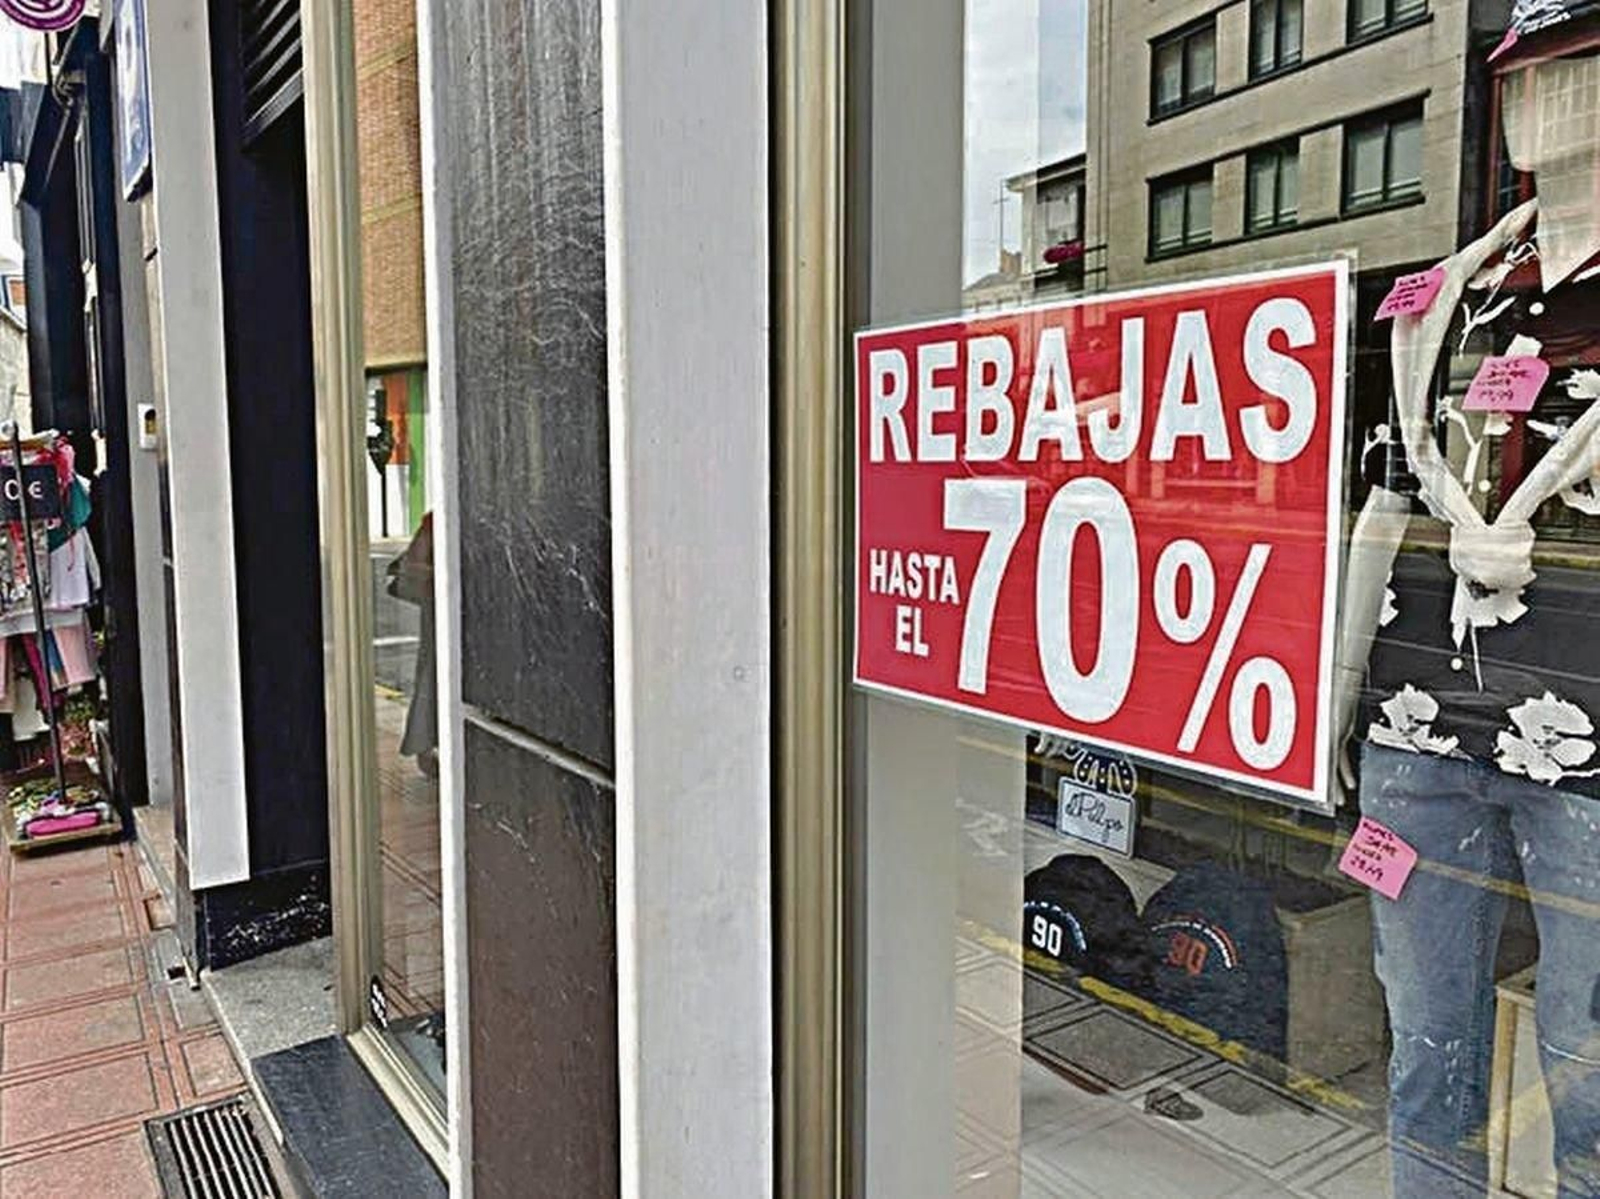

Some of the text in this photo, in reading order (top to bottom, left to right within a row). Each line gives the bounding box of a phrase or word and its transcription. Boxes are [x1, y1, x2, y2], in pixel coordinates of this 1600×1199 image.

[868, 297, 1318, 464] REBAJAS
[868, 548, 960, 605] HASTA
[895, 605, 930, 658] EL
[942, 476, 1297, 770] 70%
[1031, 914, 1063, 957] 90
